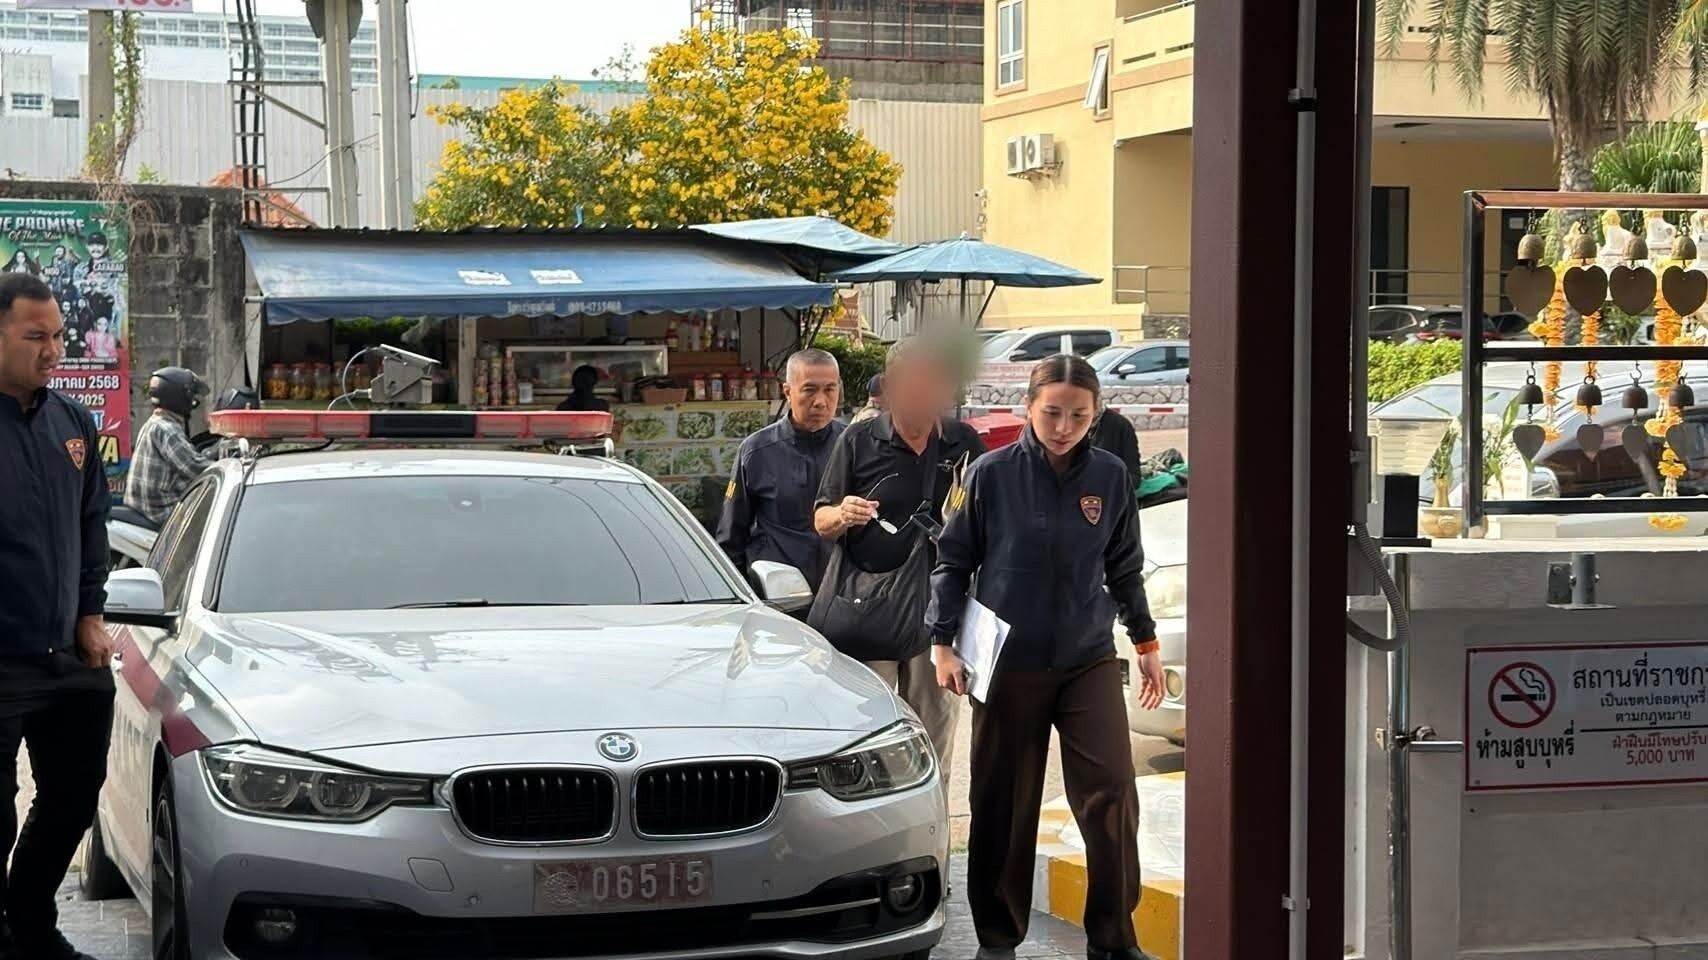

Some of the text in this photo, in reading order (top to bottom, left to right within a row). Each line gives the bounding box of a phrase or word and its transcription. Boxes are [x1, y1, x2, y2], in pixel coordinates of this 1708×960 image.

[15, 216, 85, 237] PROMISE
[88, 375, 119, 389] 2568
[1572, 651, 1708, 690] สถานที่ราชก
[1615, 710, 1692, 726] ตามกฎหมาย
[1476, 719, 1575, 769] ห้ามสูบบุหรี่
[1625, 748, 1695, 766] 5,000 บาท
[592, 859, 704, 901] 06515
